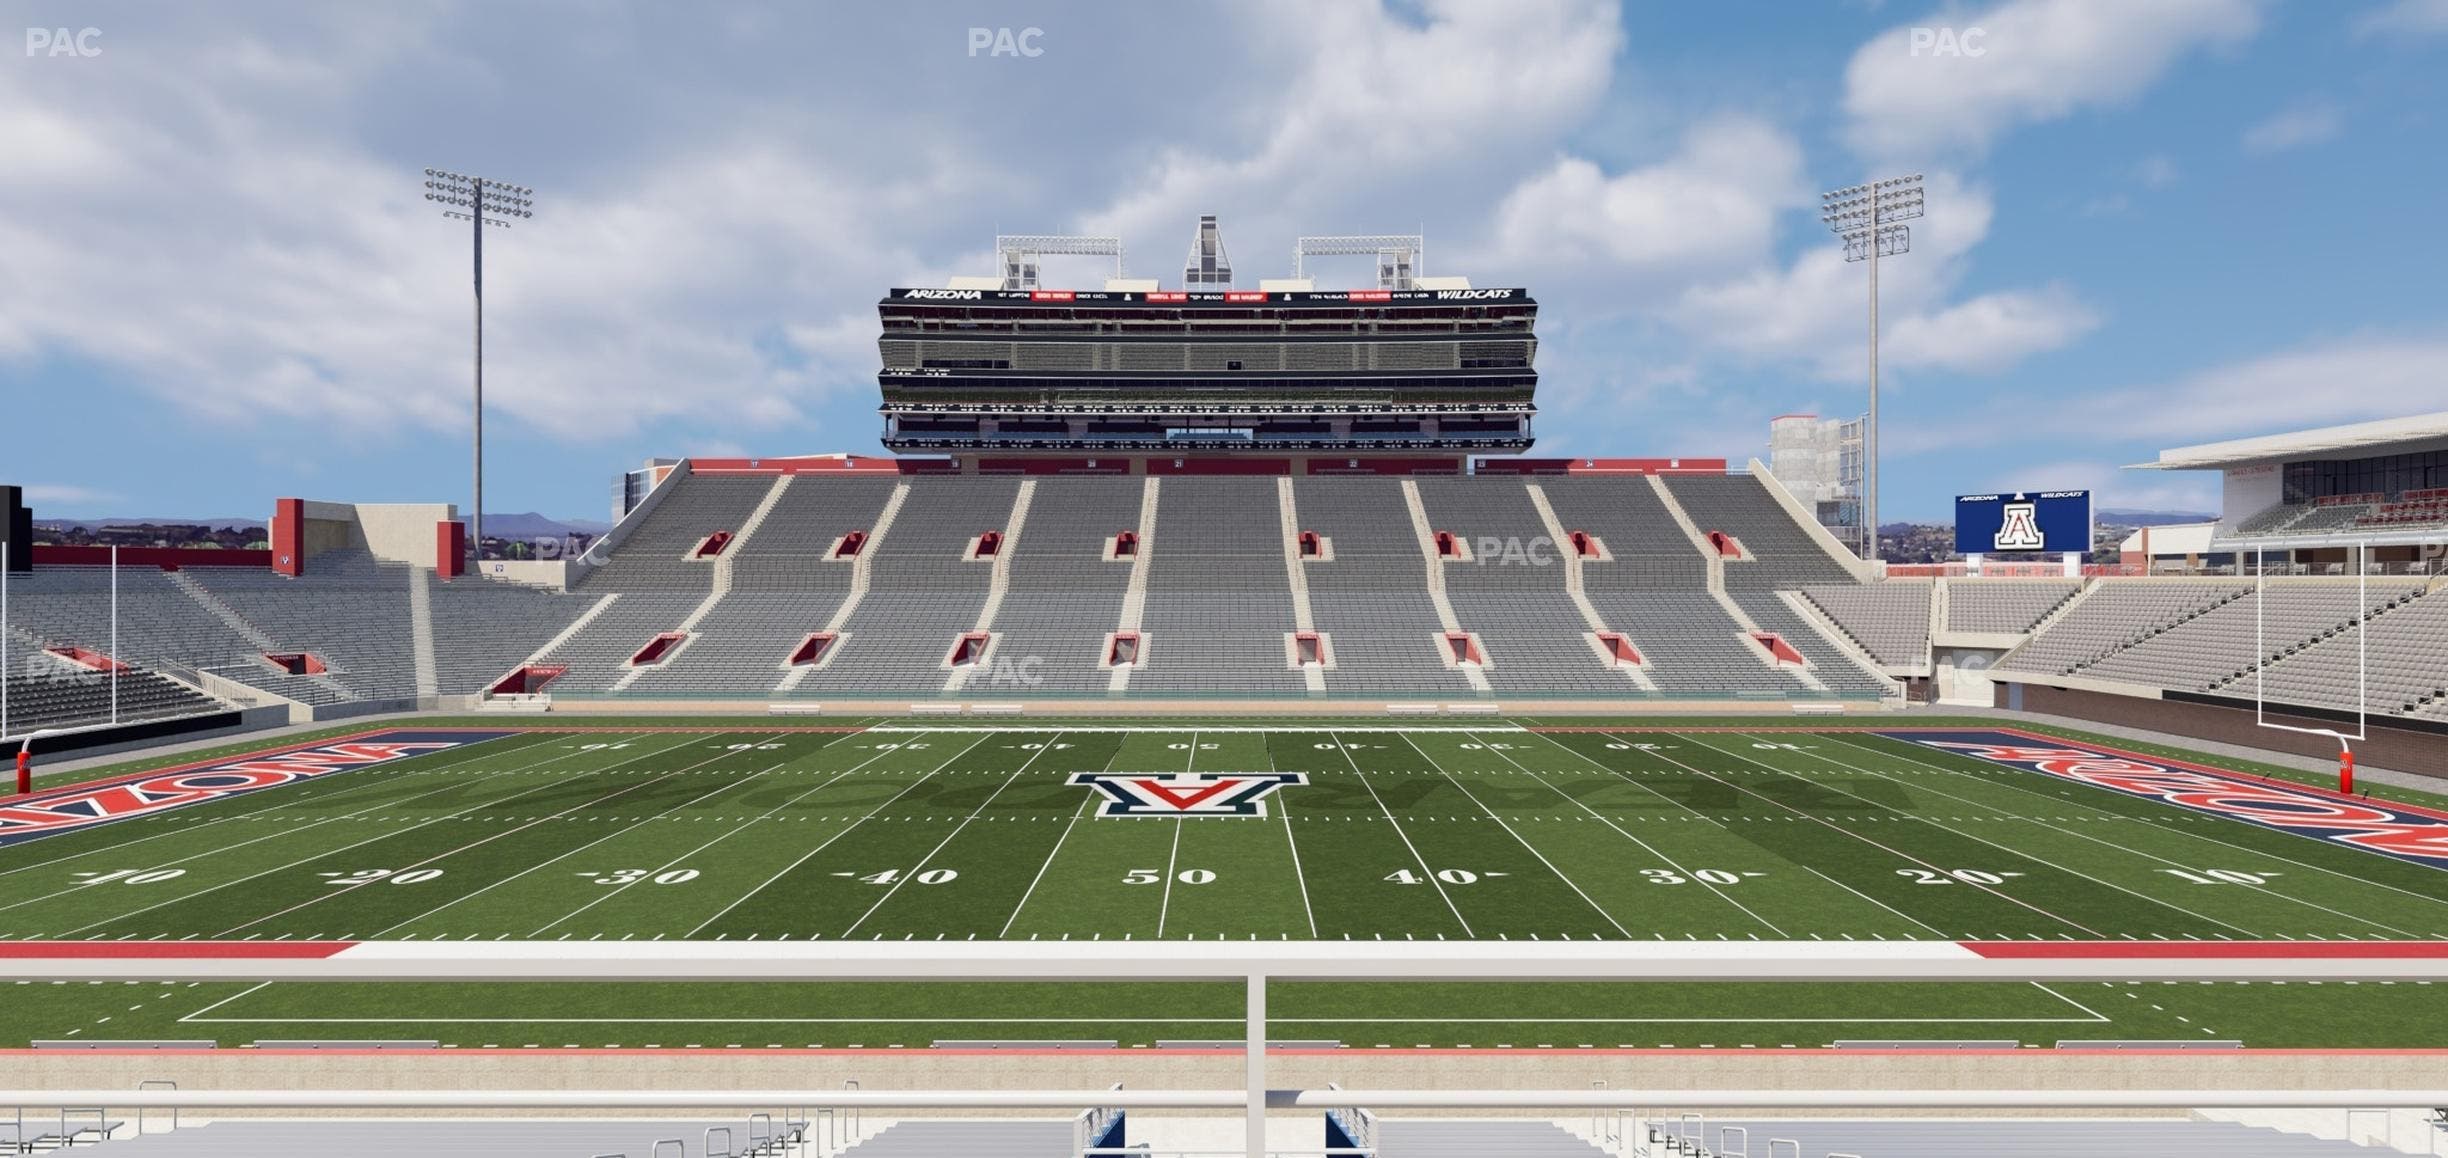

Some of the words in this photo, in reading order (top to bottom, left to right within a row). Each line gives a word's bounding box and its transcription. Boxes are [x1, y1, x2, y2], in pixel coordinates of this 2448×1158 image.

[904, 289, 981, 299] ARIZONA
[1437, 289, 1512, 299] WILDCATS
[2041, 491, 2083, 499] WILDCATS
[1995, 503, 2044, 549] A
[1286, 779, 1917, 809] BEAR
[68, 869, 186, 885] 10
[325, 869, 444, 885] 20
[594, 869, 700, 885] 30
[858, 869, 958, 885] 40
[1122, 869, 1217, 885] 50
[1383, 869, 1478, 885] 40
[1639, 869, 1739, 885] 30
[1896, 869, 2003, 885] 20
[2153, 869, 2266, 885] 10
